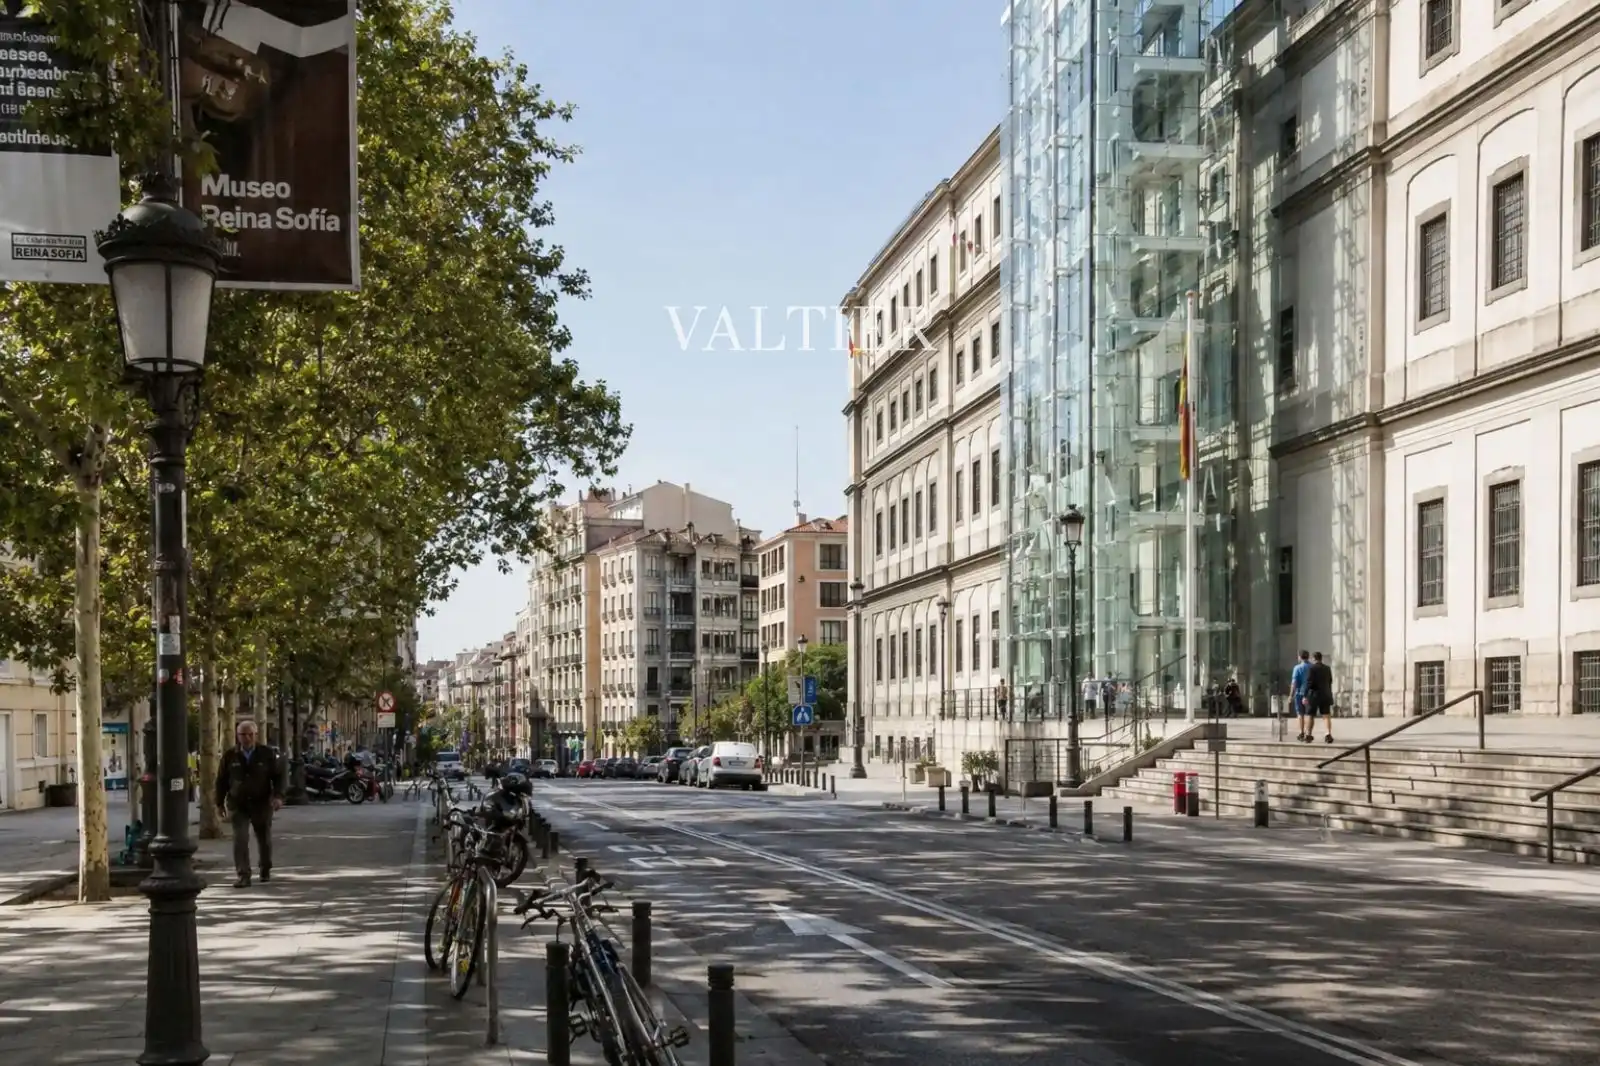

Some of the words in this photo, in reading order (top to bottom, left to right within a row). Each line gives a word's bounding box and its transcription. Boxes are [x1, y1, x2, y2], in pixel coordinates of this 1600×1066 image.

[201, 174, 291, 198] Museo
[201, 204, 272, 229] Reina
[275, 206, 340, 232] Sofía
[15, 247, 49, 258] REINA
